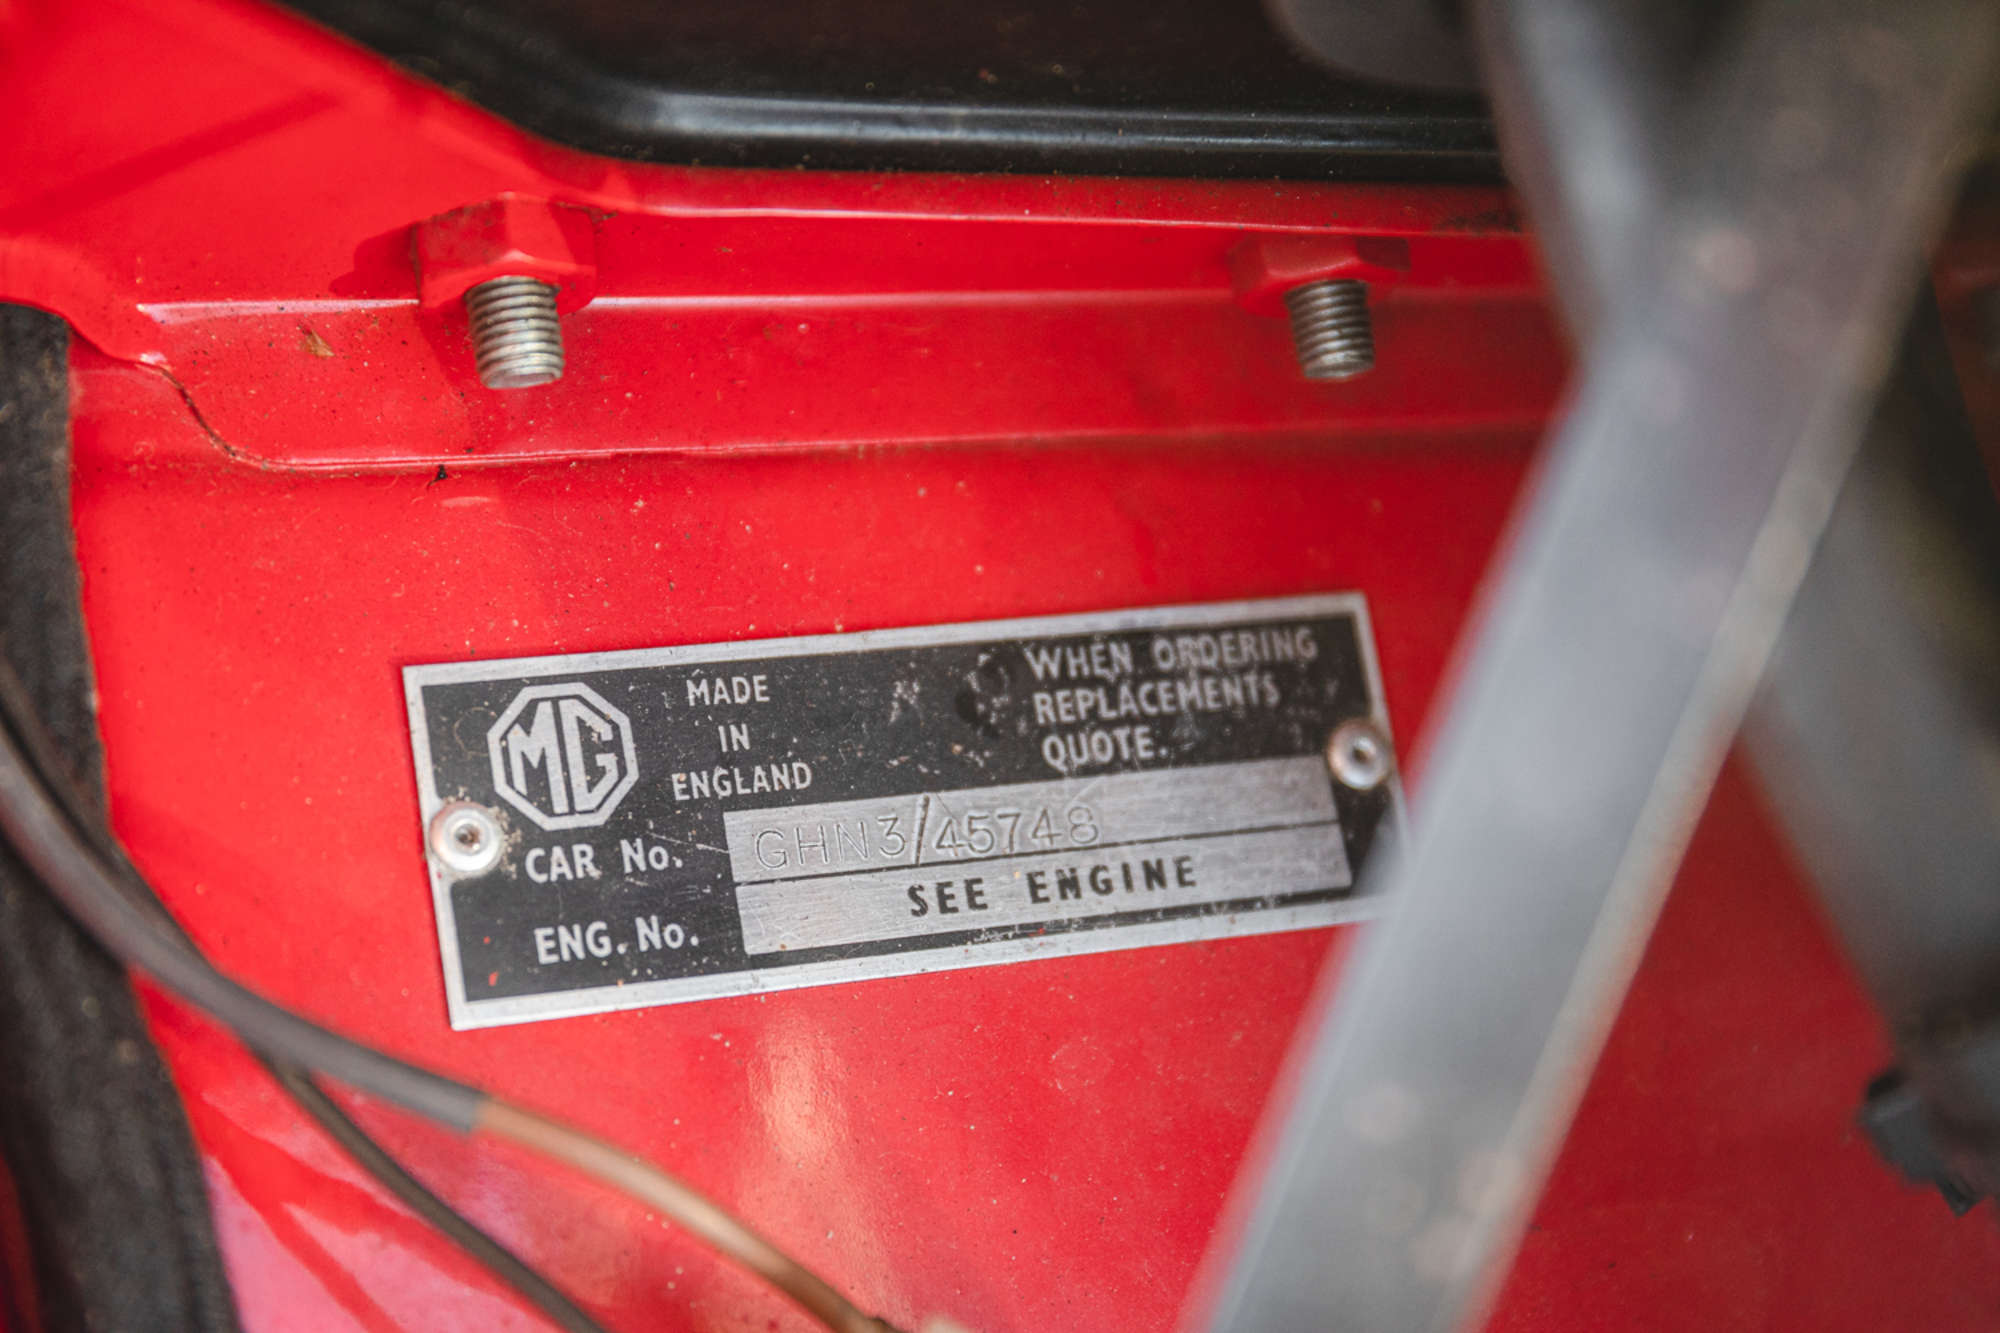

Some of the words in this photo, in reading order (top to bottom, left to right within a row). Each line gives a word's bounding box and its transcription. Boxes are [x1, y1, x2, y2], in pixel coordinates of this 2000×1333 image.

[1025, 642, 1132, 682] WHEN
[1151, 627, 1318, 671] ORDERING
[686, 675, 770, 707] MADE
[1033, 673, 1281, 726] REPLACEMENTS
[506, 698, 619, 814] MG
[718, 723, 750, 752] IN
[1041, 726, 1169, 773] QUOTE.
[671, 763, 813, 801] ENGLAND
[525, 843, 600, 884] CAR
[620, 839, 683, 873] No.
[755, 792, 1099, 870] GHN3/45748
[534, 921, 627, 965] ENG.
[636, 915, 699, 953] No.
[907, 877, 988, 918] SEE
[1027, 855, 1197, 904] ENGINE
